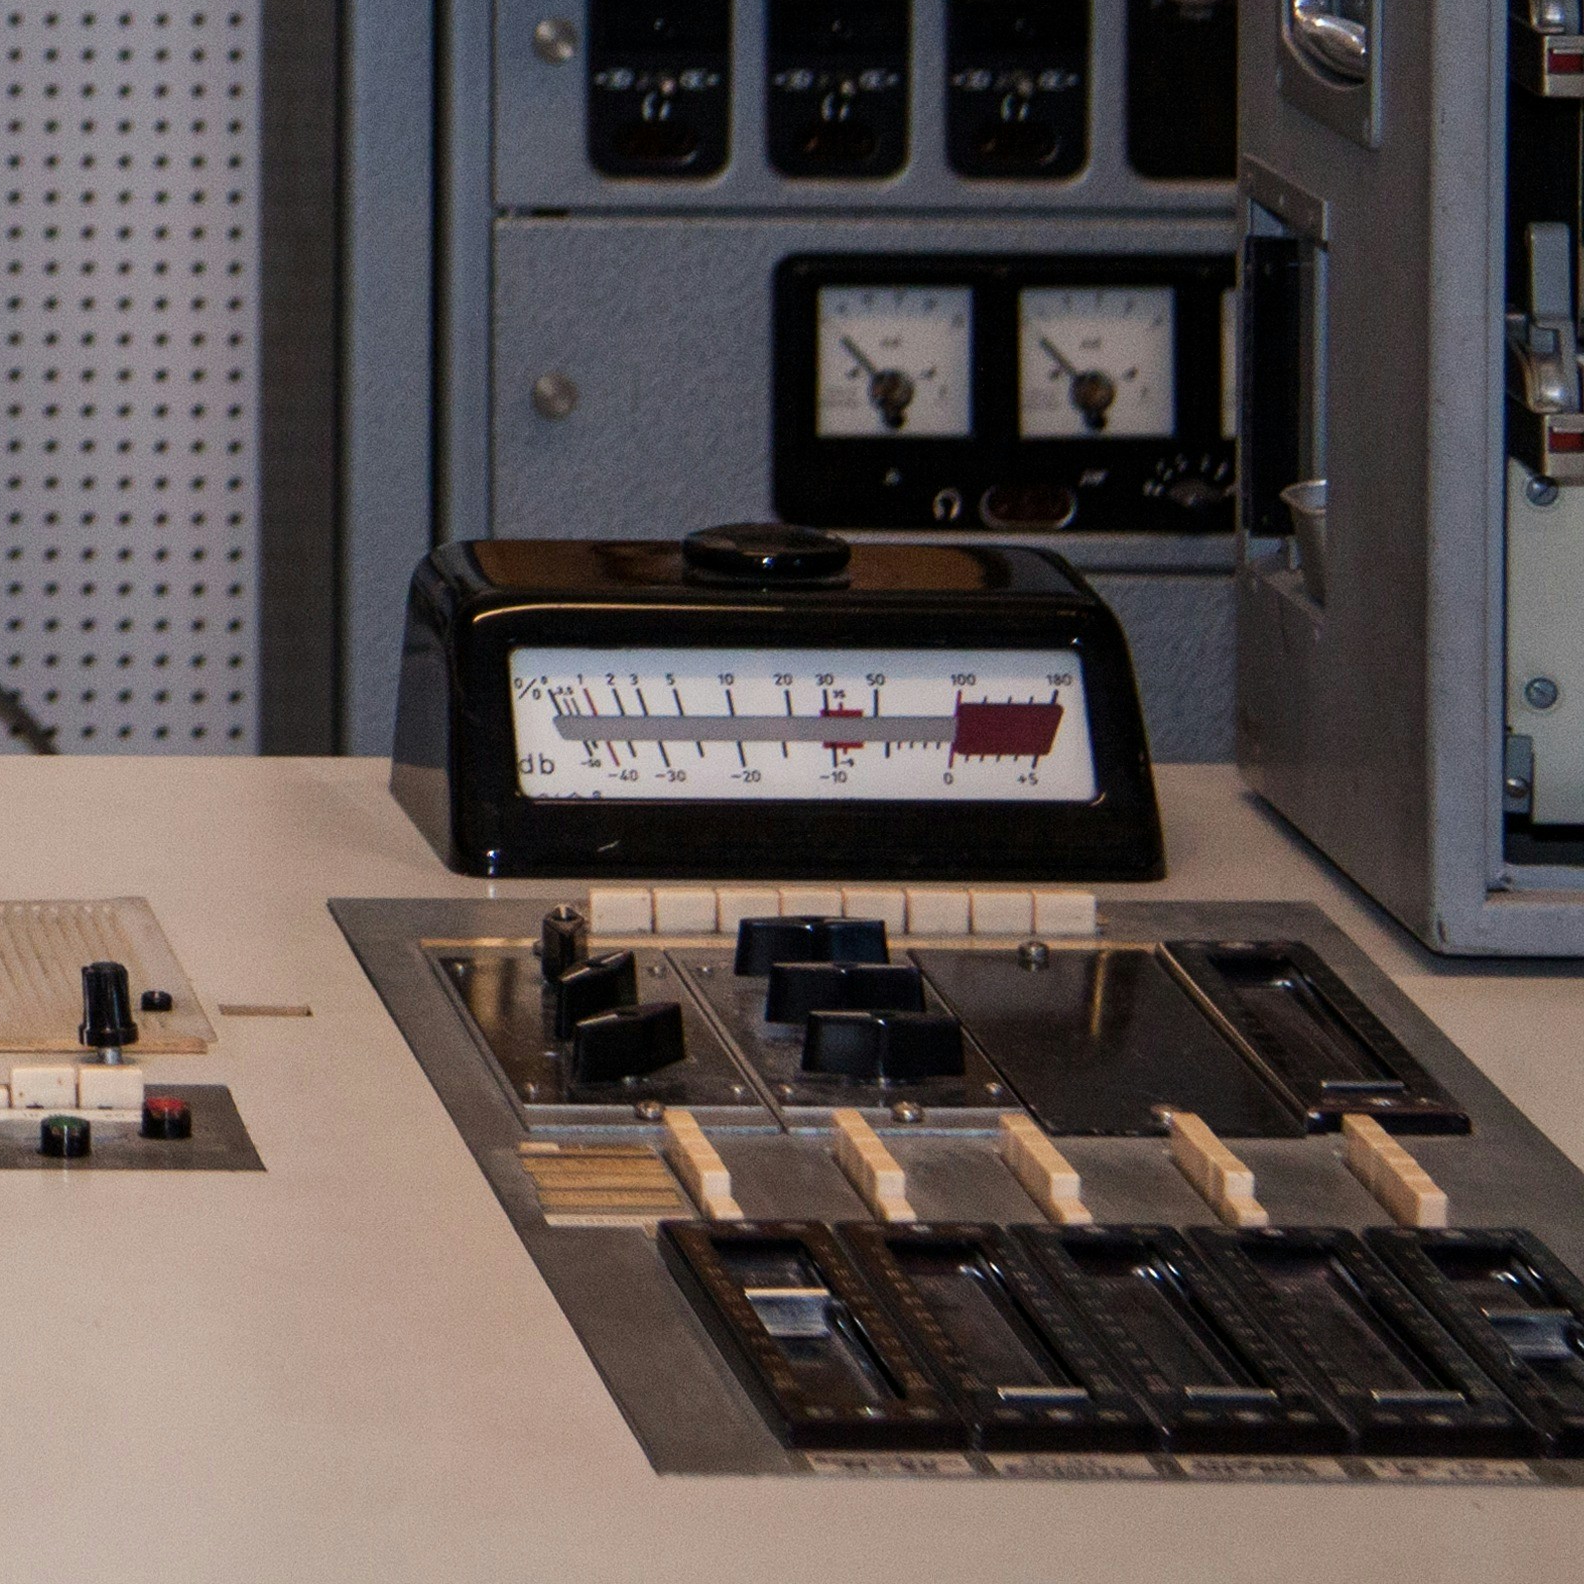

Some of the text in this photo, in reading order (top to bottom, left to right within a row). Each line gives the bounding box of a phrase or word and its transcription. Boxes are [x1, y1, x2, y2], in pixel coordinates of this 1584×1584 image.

[577, 673, 584, 685] 1
[606, 673, 616, 686] 2
[629, 673, 639, 686] 3
[666, 673, 676, 686] 5
[717, 673, 734, 686] 10
[774, 673, 793, 686] 20
[815, 673, 834, 686] 30
[865, 673, 886, 686] 50
[950, 673, 976, 686] 100
[1046, 673, 1072, 686] 180
[607, 769, 639, 782] -40
[654, 769, 687, 782] -30
[731, 770, 762, 783] -20
[819, 771, 848, 784] -10
[942, 772, 953, 785] 0
[1017, 772, 1038, 786] +5
